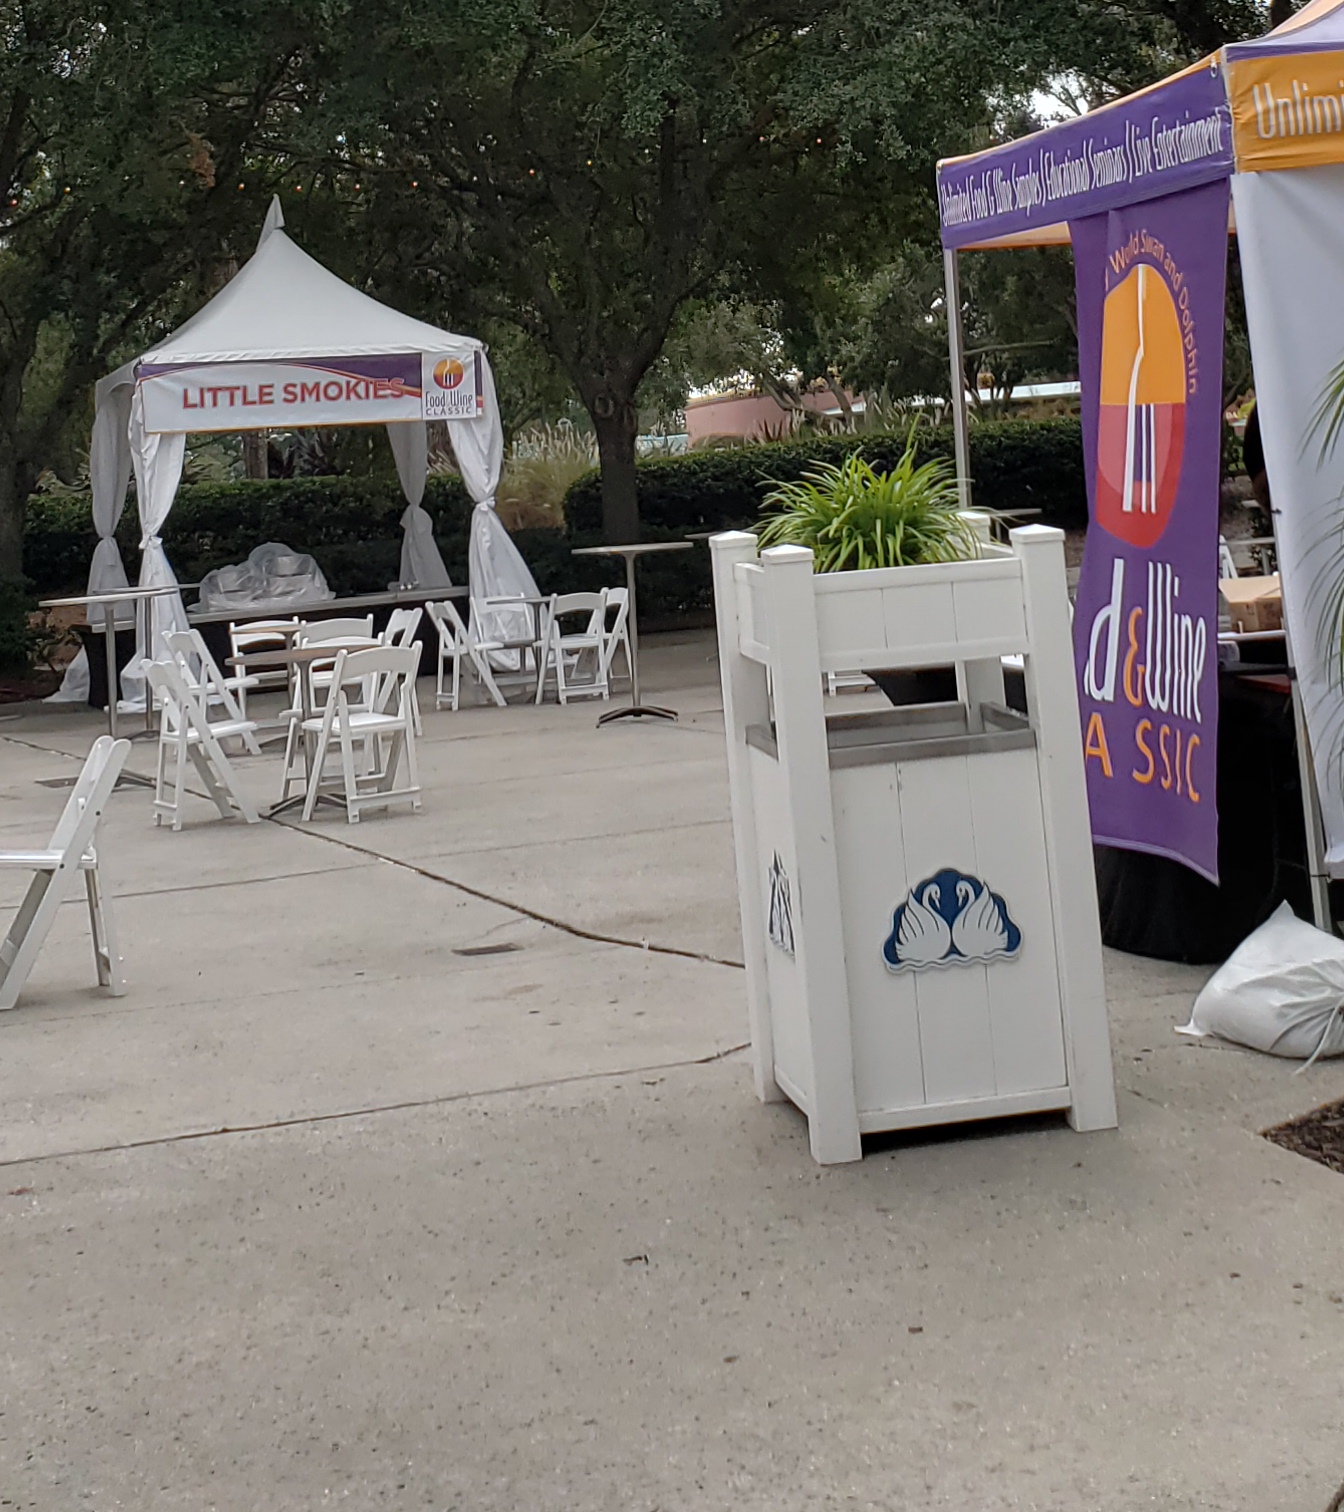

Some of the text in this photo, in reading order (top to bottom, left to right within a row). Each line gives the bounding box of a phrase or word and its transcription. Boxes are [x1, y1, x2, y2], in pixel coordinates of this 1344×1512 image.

[941, 176, 971, 227] Unlimited
[969, 172, 989, 221] Food
[993, 167, 1013, 214] Wine
[1011, 157, 1042, 217] Samples
[1045, 139, 1090, 201] Educational
[1088, 137, 1127, 190] Seminars
[1131, 124, 1153, 177] Live
[1151, 107, 1223, 171] Entertainment
[1140, 228, 1165, 261] Swan
[1163, 252, 1183, 292] and
[1178, 286, 1198, 394] Dolphin
[182, 377, 405, 410] LITTLE SMOKIES
[425, 407, 472, 416] CLASSIC
[1085, 712, 1200, 803] ASSIC
